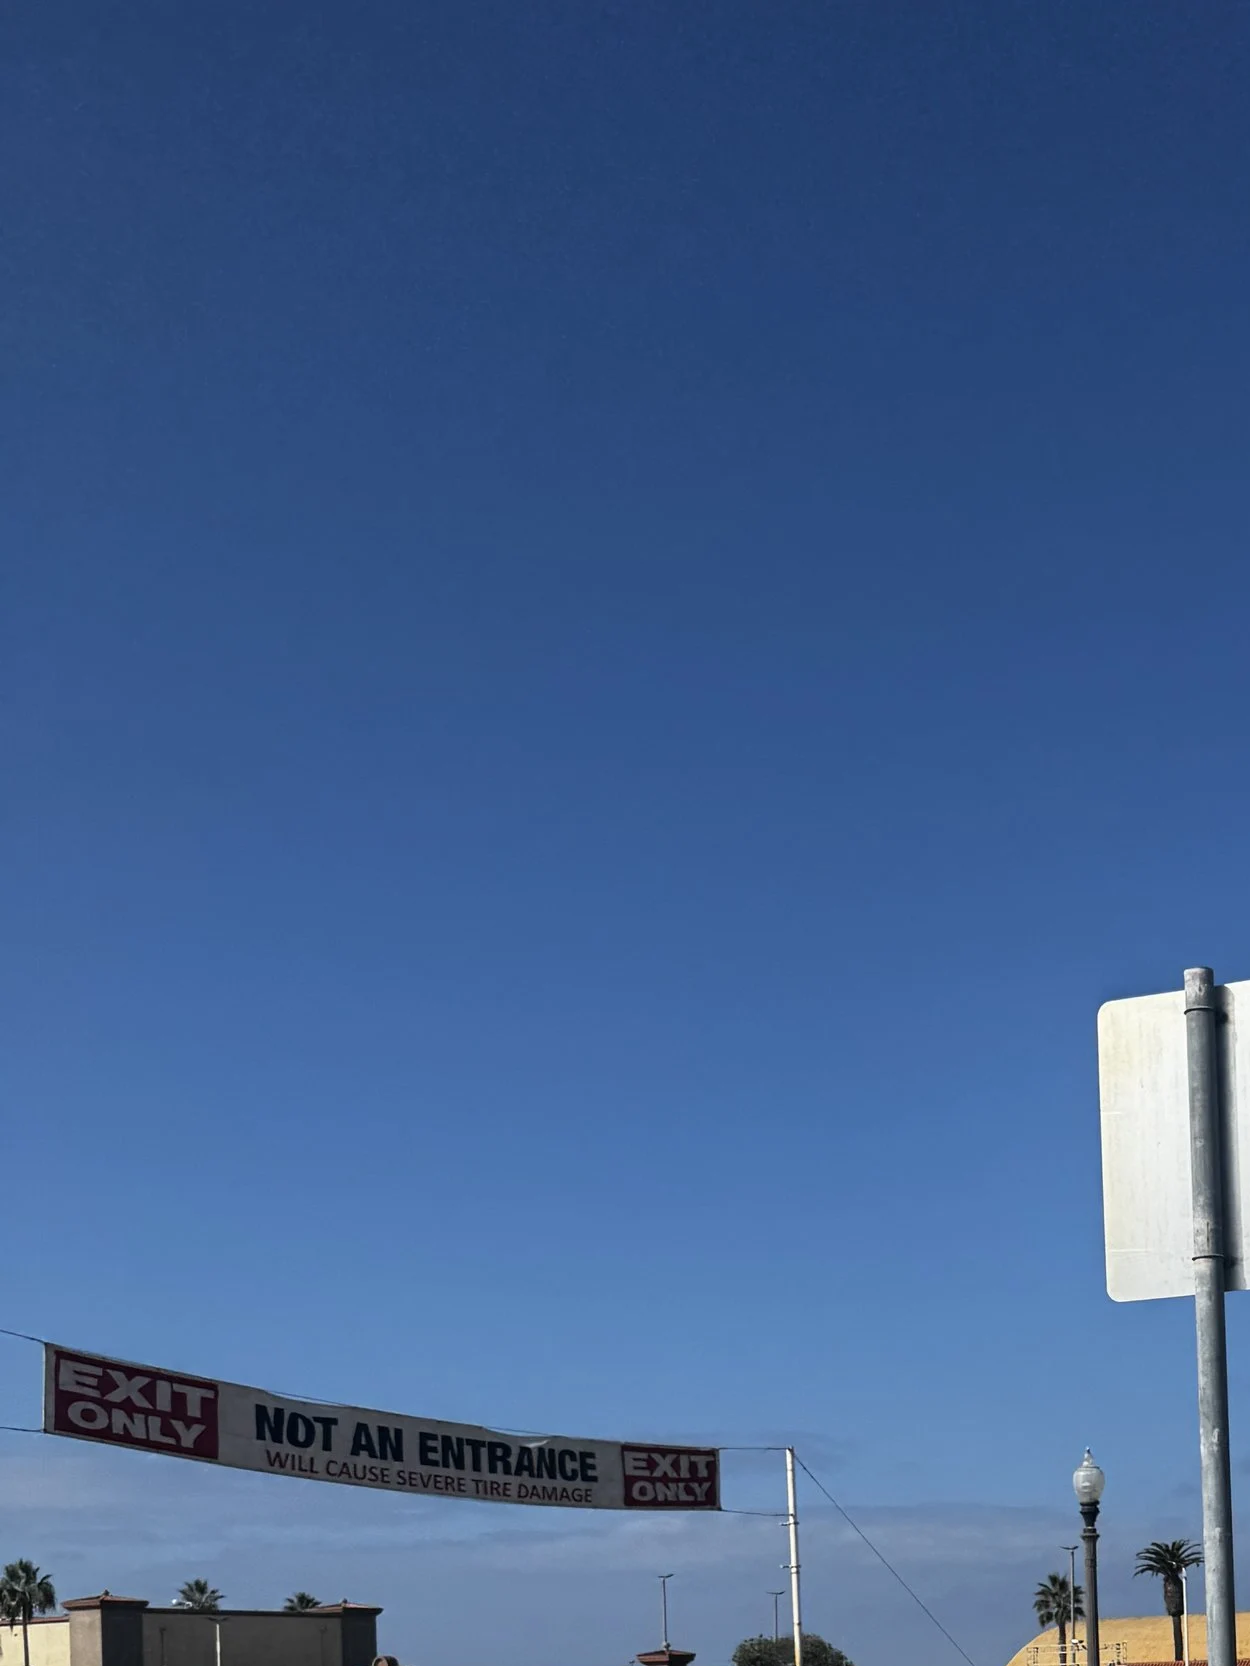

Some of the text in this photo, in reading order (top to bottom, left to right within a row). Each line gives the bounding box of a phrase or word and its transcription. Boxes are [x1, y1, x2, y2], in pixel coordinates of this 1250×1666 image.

[58, 1359, 216, 1419] EXIT
[67, 1401, 207, 1449] ONLY
[255, 1403, 599, 1483] NOT AN ENTRANCE
[266, 1449, 593, 1503] WILL CAUSE SEVERE TIRE DAMAGE
[622, 1451, 716, 1479] EXIT
[631, 1480, 712, 1503] ONLY
